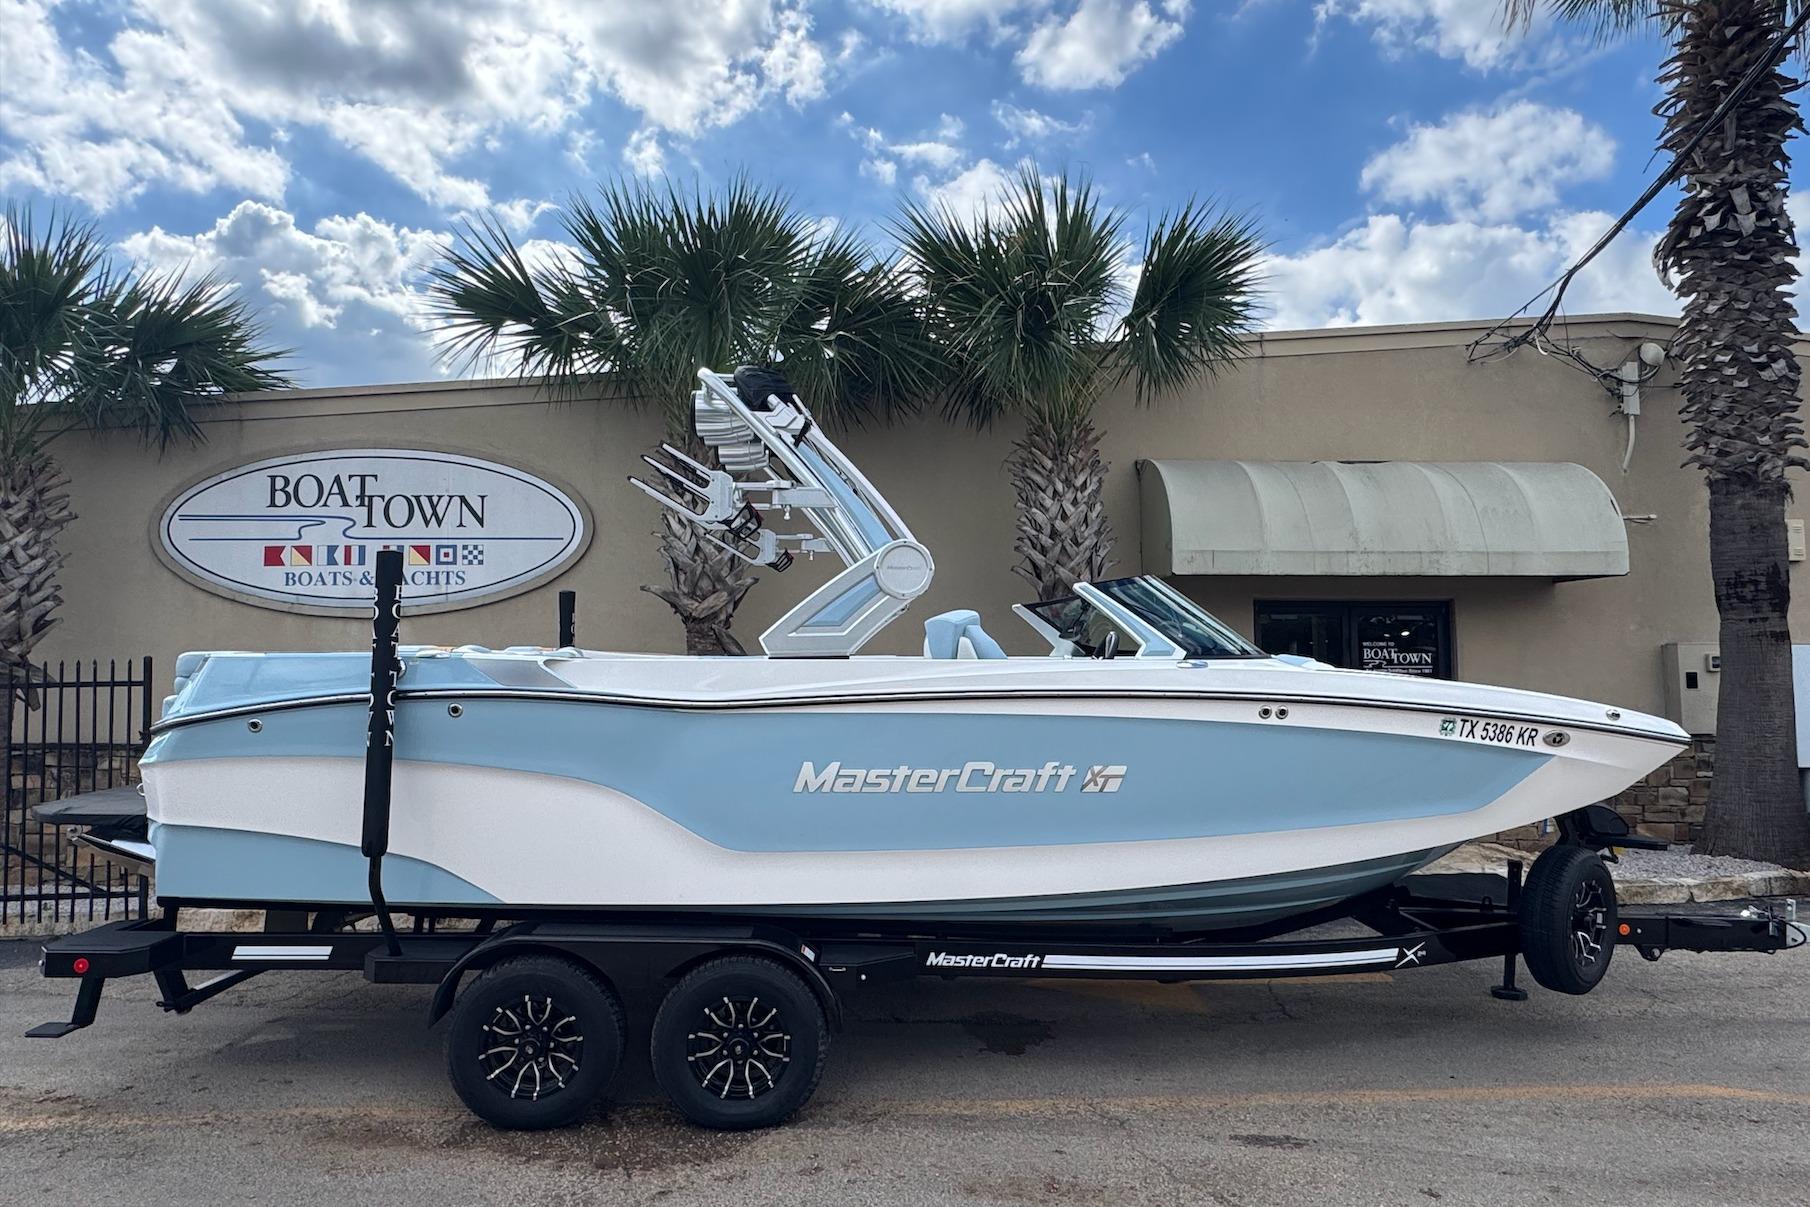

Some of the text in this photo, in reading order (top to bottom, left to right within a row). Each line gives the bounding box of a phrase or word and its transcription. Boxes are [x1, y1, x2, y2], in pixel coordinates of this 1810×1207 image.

[284, 571, 466, 587] BOATS & ACHTS
[1458, 718, 1540, 747] TX 5386 KR
[792, 761, 1127, 793] MasterCraft XT
[925, 951, 1041, 969] MasterCraft
